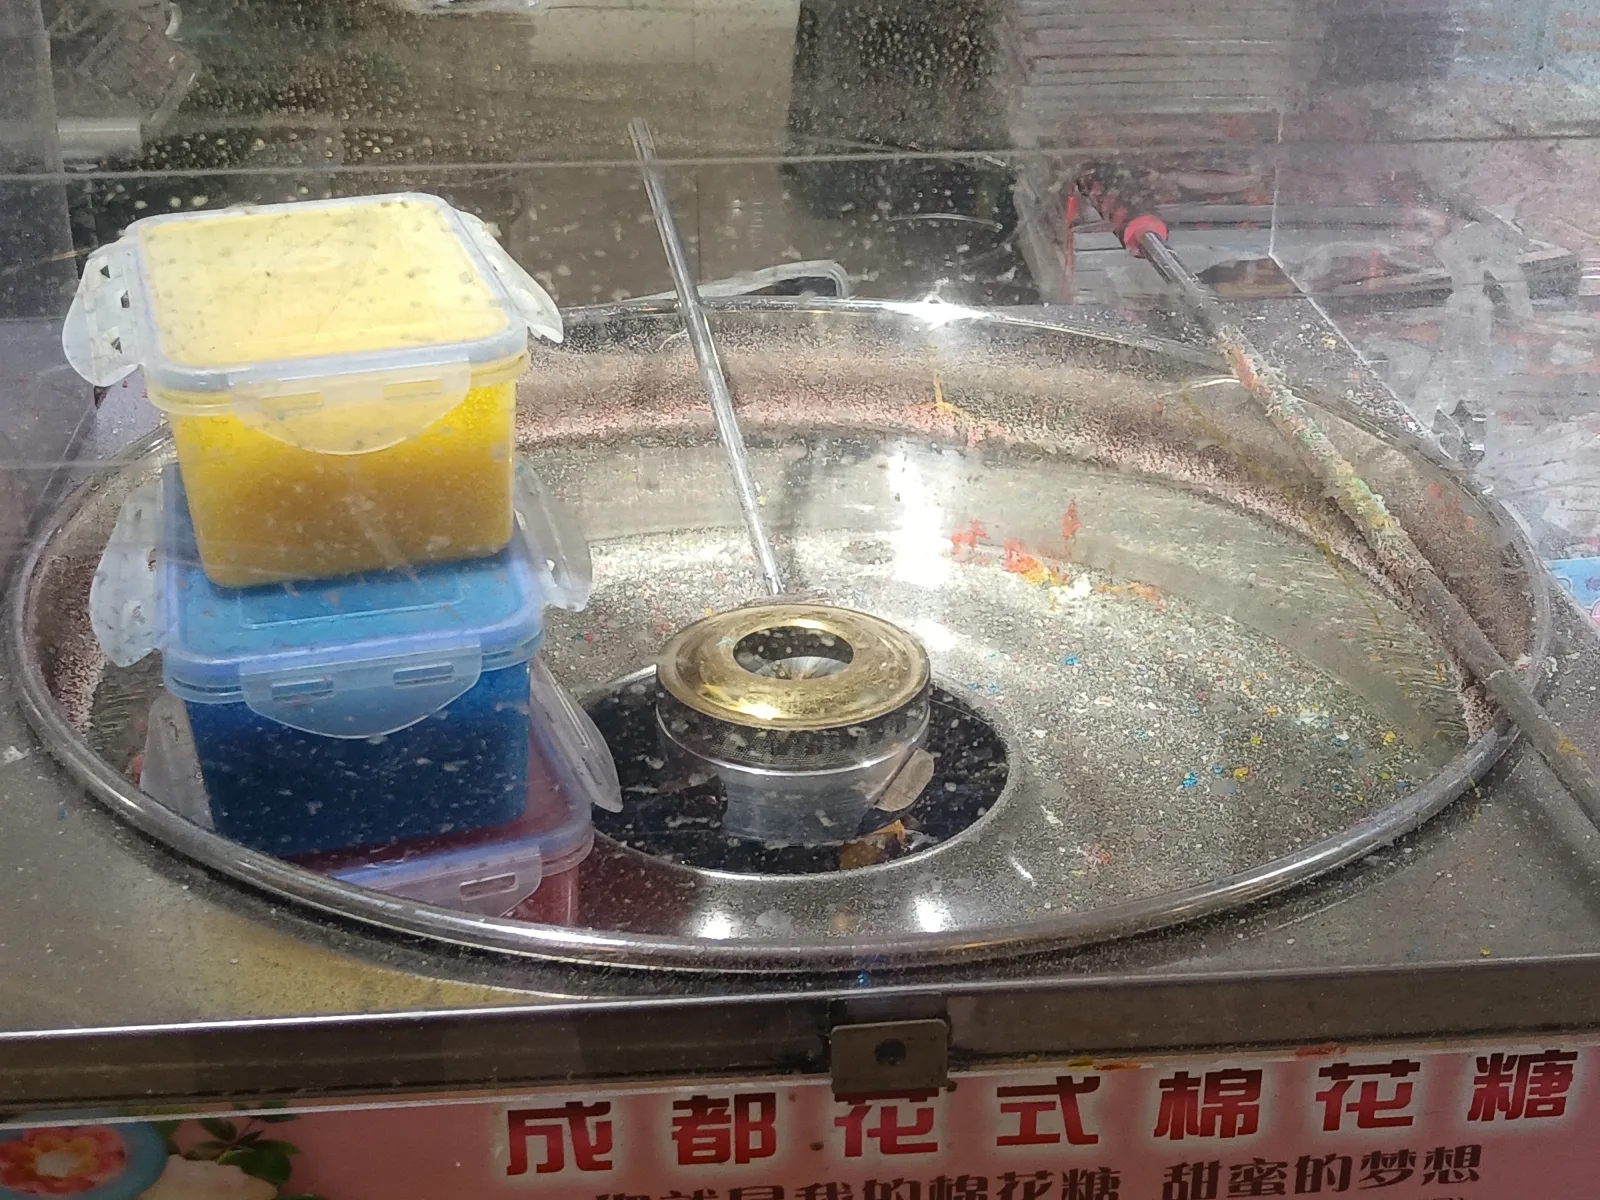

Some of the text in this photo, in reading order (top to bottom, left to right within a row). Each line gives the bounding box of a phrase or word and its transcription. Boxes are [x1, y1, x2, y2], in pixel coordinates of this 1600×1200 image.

[507, 1050, 1578, 1175] 成都花式棉花糖
[596, 1144, 1482, 1200] 的棉花糖 甜蜜的梦想
